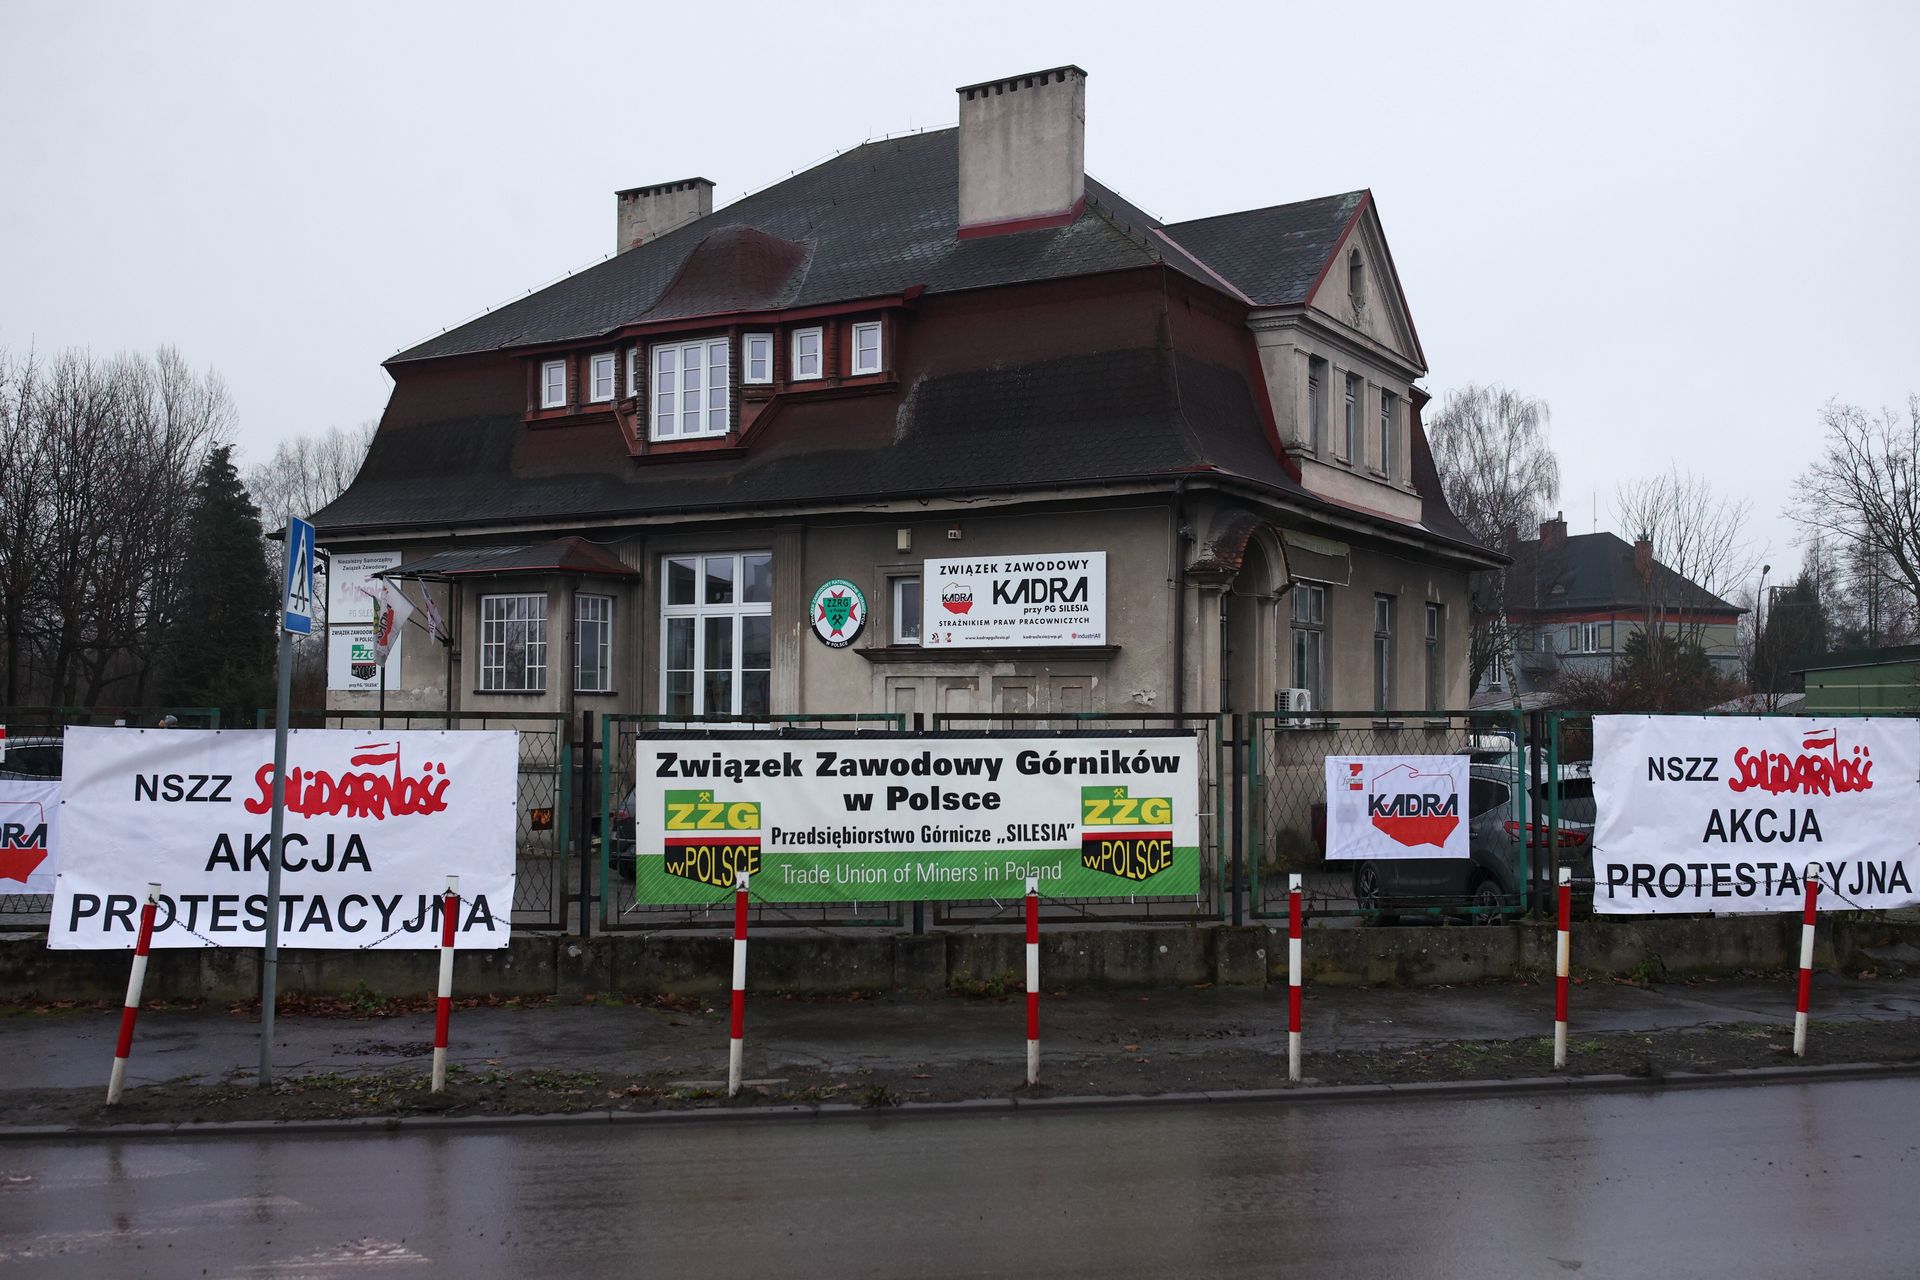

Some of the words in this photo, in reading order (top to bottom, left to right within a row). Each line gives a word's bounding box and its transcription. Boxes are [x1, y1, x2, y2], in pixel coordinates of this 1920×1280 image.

[939, 563, 999, 577] ZWIĄZEK
[1004, 559, 1090, 573] ZAWODOWY
[827, 599, 849, 608] ZZRG
[941, 593, 973, 603] KADRA
[992, 576, 1088, 605] KADRA
[359, 609, 374, 617] SILES
[938, 618, 990, 627] STRAŻNIKIEM
[993, 618, 1016, 626] PRAW
[1019, 616, 1090, 626] PRACOWNICZYCH
[1023, 607, 1042, 615] przy
[1044, 605, 1056, 613] PG
[1059, 604, 1089, 613] SILESIA
[831, 640, 849, 648] POLSCE
[656, 751, 803, 784] Związek
[815, 750, 1004, 783] Zawodowy
[1015, 748, 1181, 776] Górników
[1648, 756, 1720, 783] NSZZ
[134, 774, 232, 803] NSZZ
[843, 793, 874, 812] w
[886, 785, 1001, 812] Polsce
[666, 802, 760, 831] ZZG
[1083, 798, 1172, 825] ZZG
[1368, 793, 1459, 817] KADRA
[771, 826, 915, 849] Przedsiębiorstwo
[921, 824, 991, 844] Górnicze
[1702, 807, 1824, 844] AKCJA
[204, 833, 372, 873] AKCJA
[781, 863, 830, 885] Trade
[836, 862, 888, 885] Union
[893, 862, 912, 884] of
[916, 862, 978, 883] Miners
[983, 861, 1000, 882] in
[1004, 860, 1063, 882] Poland
[1606, 860, 1913, 900] PROTESTACYJNA
[68, 893, 497, 933] PROTESTACYJNA
